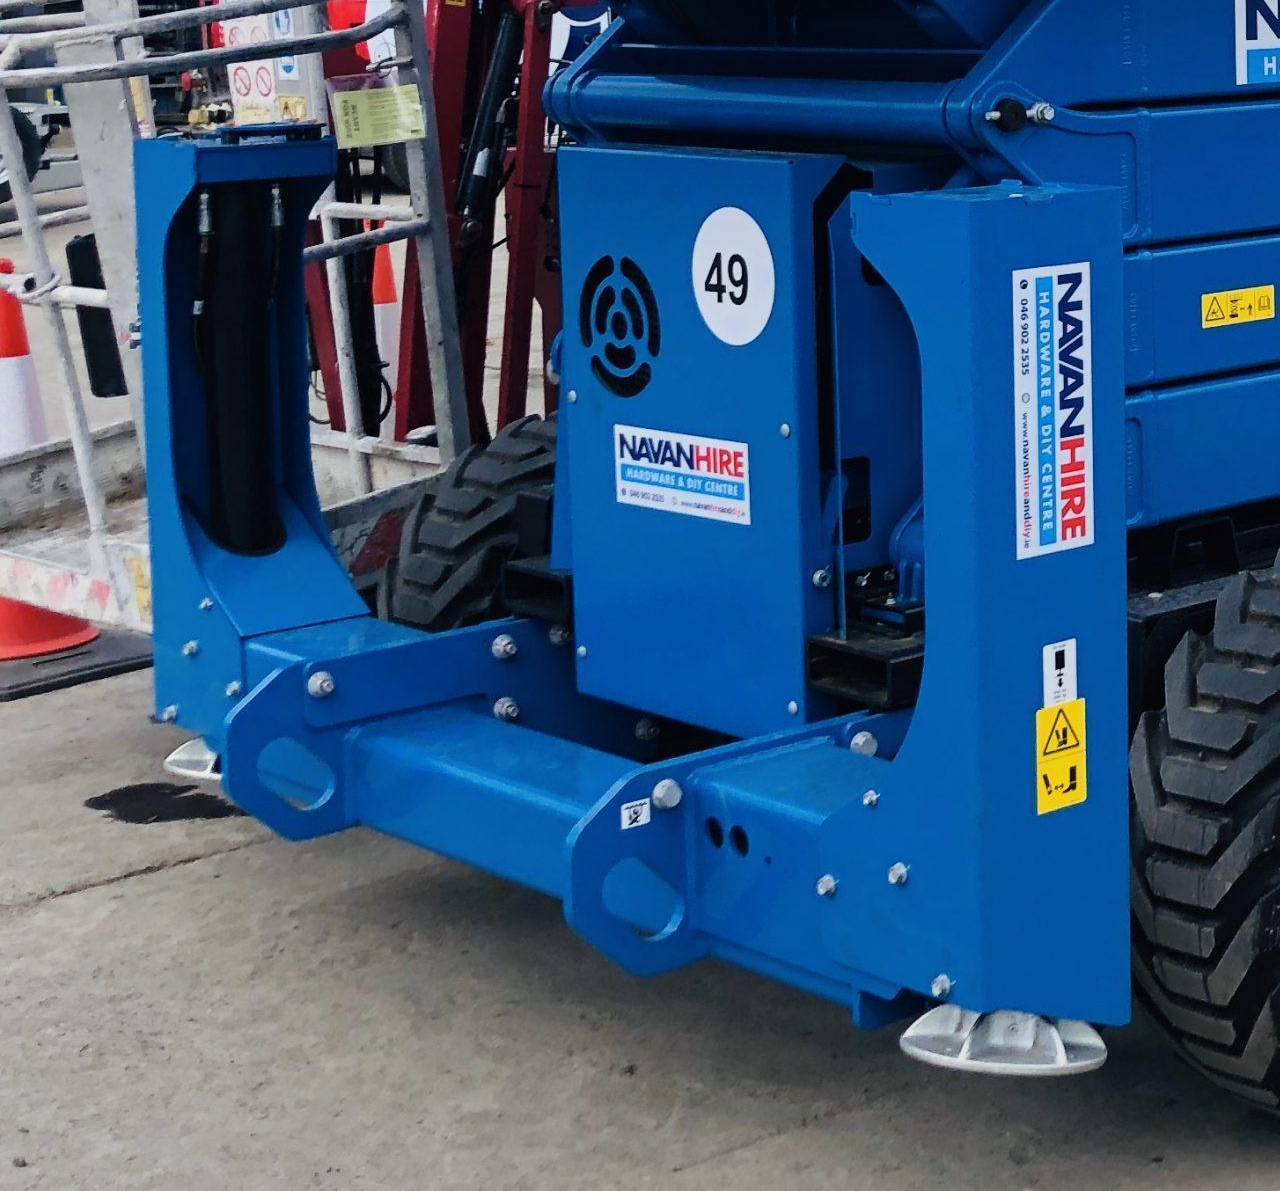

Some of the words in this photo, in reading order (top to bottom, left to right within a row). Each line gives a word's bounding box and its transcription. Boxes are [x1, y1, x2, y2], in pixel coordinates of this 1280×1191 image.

[704, 251, 749, 306] 49
[1019, 298, 1030, 322] 046
[1020, 323, 1030, 346] 902
[1038, 291, 1053, 399] HARDWARE
[1020, 348, 1030, 376] 2535
[1041, 404, 1053, 419] &
[1057, 271, 1086, 542] NAVANHIRE
[619, 433, 745, 478] NAVANHIRE
[1041, 424, 1054, 458] DIY
[626, 467, 675, 486] HARDWARE
[704, 480, 739, 496] CENTRE
[1022, 412, 1033, 549] www.navanhireanddiy.ie
[1041, 462, 1055, 531] CENTRE
